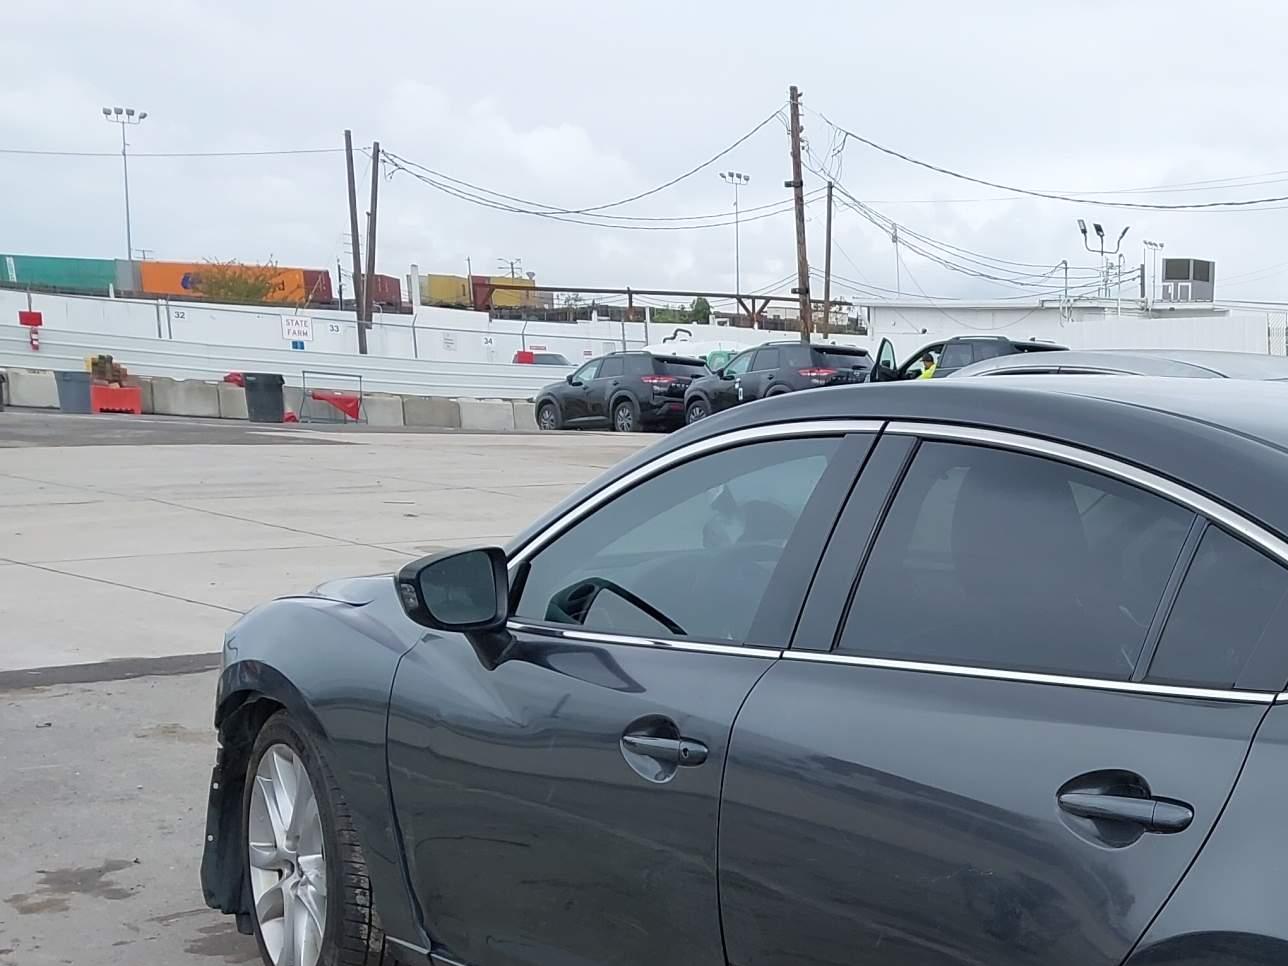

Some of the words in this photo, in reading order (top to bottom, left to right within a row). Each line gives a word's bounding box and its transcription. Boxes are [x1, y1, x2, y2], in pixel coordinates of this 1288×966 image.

[174, 311, 186, 319] 32
[286, 319, 309, 328] STATE
[287, 328, 308, 337] FARM
[329, 324, 340, 333] 33
[484, 337, 493, 345] 34
